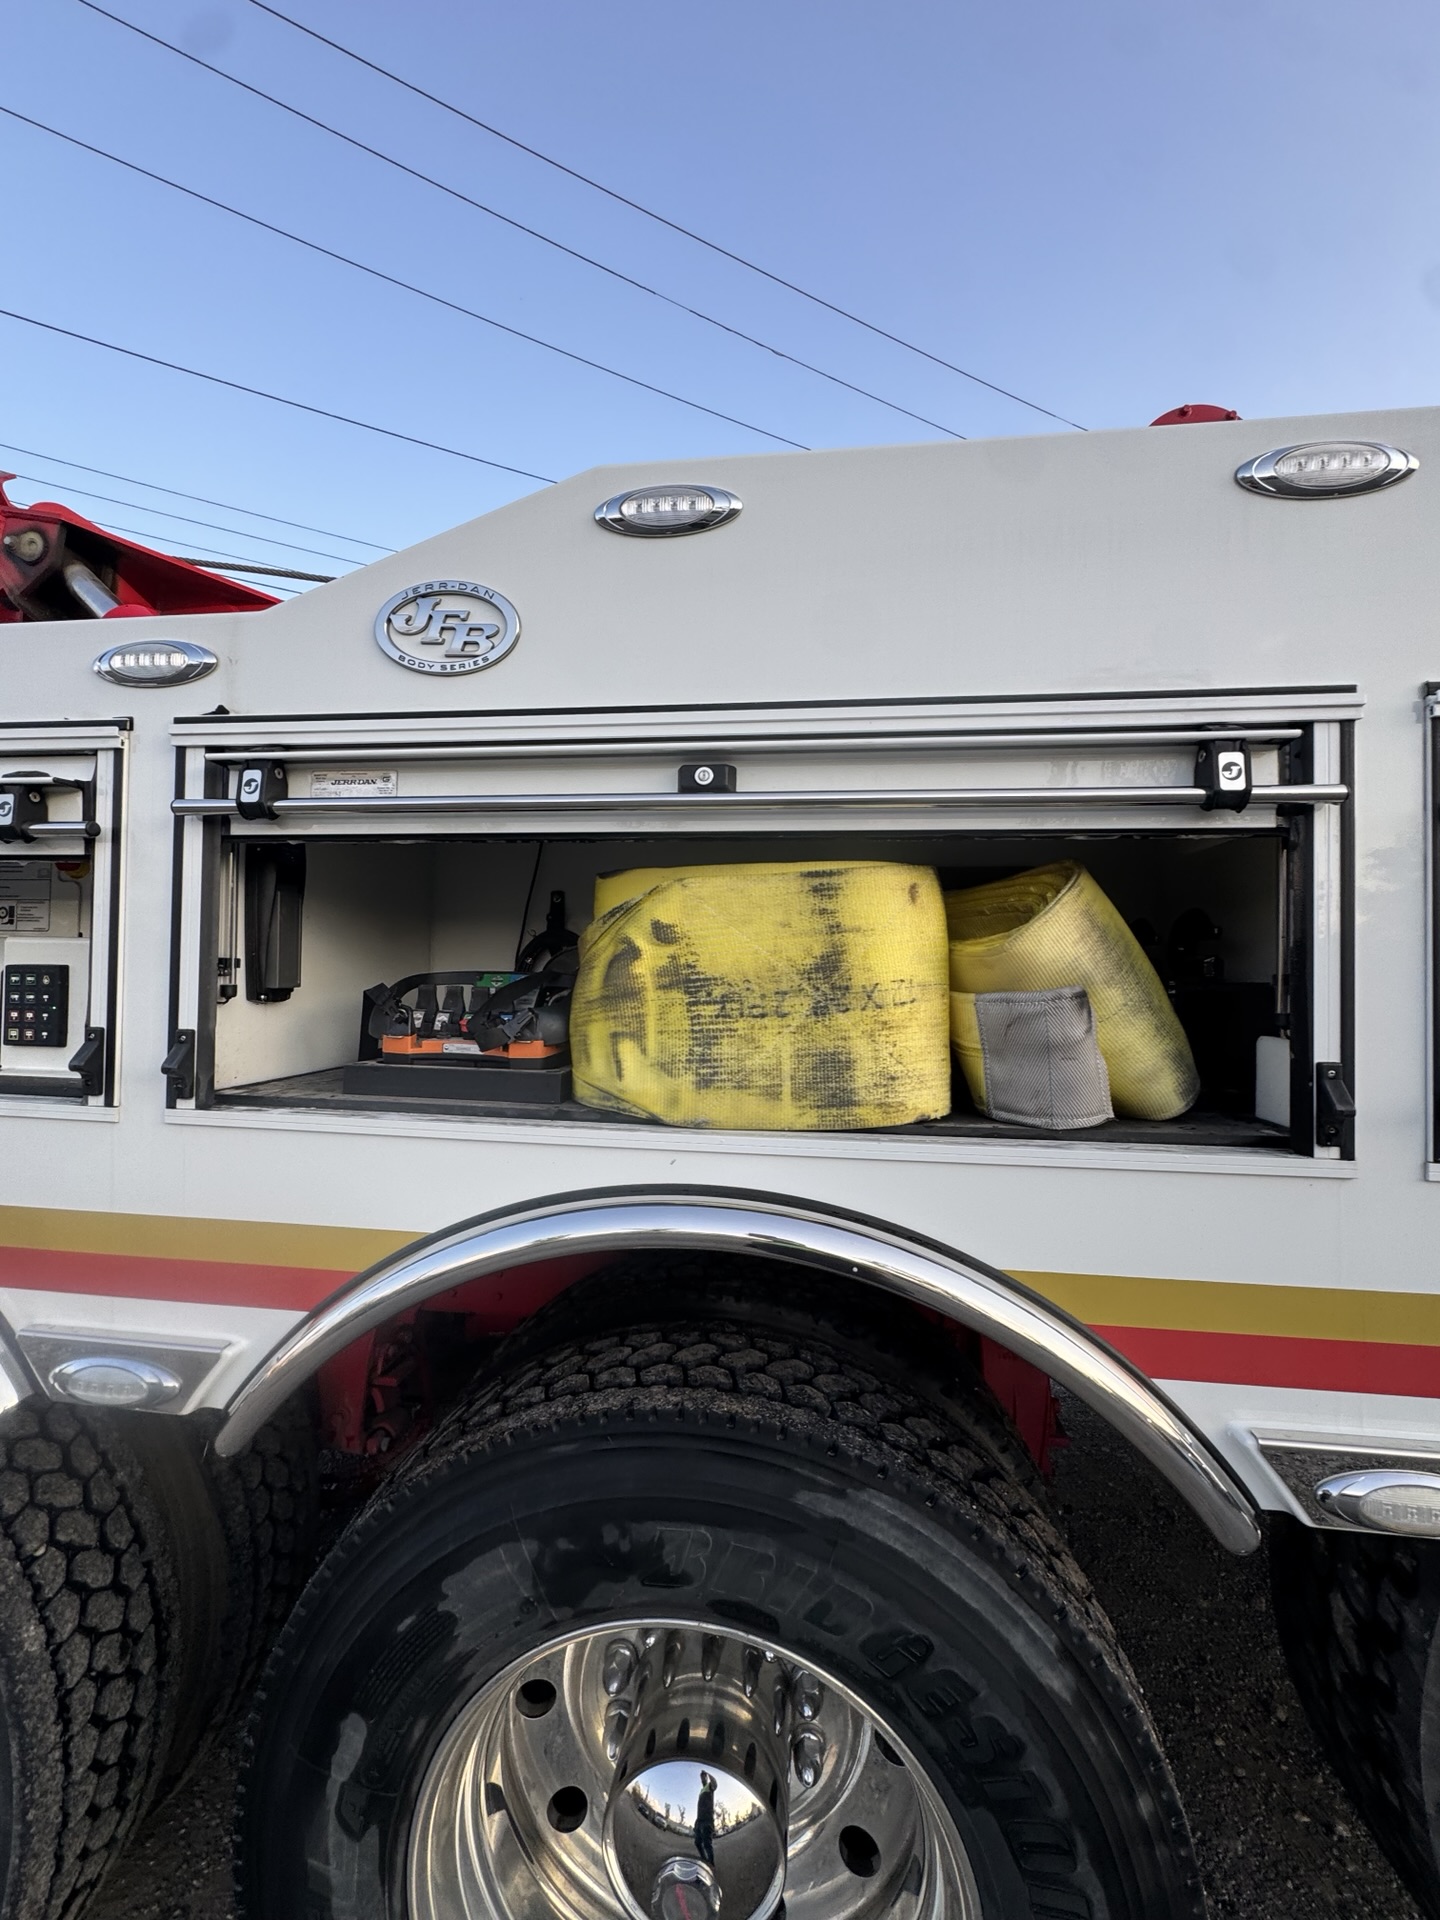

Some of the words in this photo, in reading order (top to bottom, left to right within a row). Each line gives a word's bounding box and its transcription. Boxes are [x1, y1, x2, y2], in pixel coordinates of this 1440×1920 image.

[401, 582, 495, 600] JERR-DAN
[389, 597, 500, 657] JFB
[397, 654, 435, 670] BODY
[440, 655, 490, 671] SERIES
